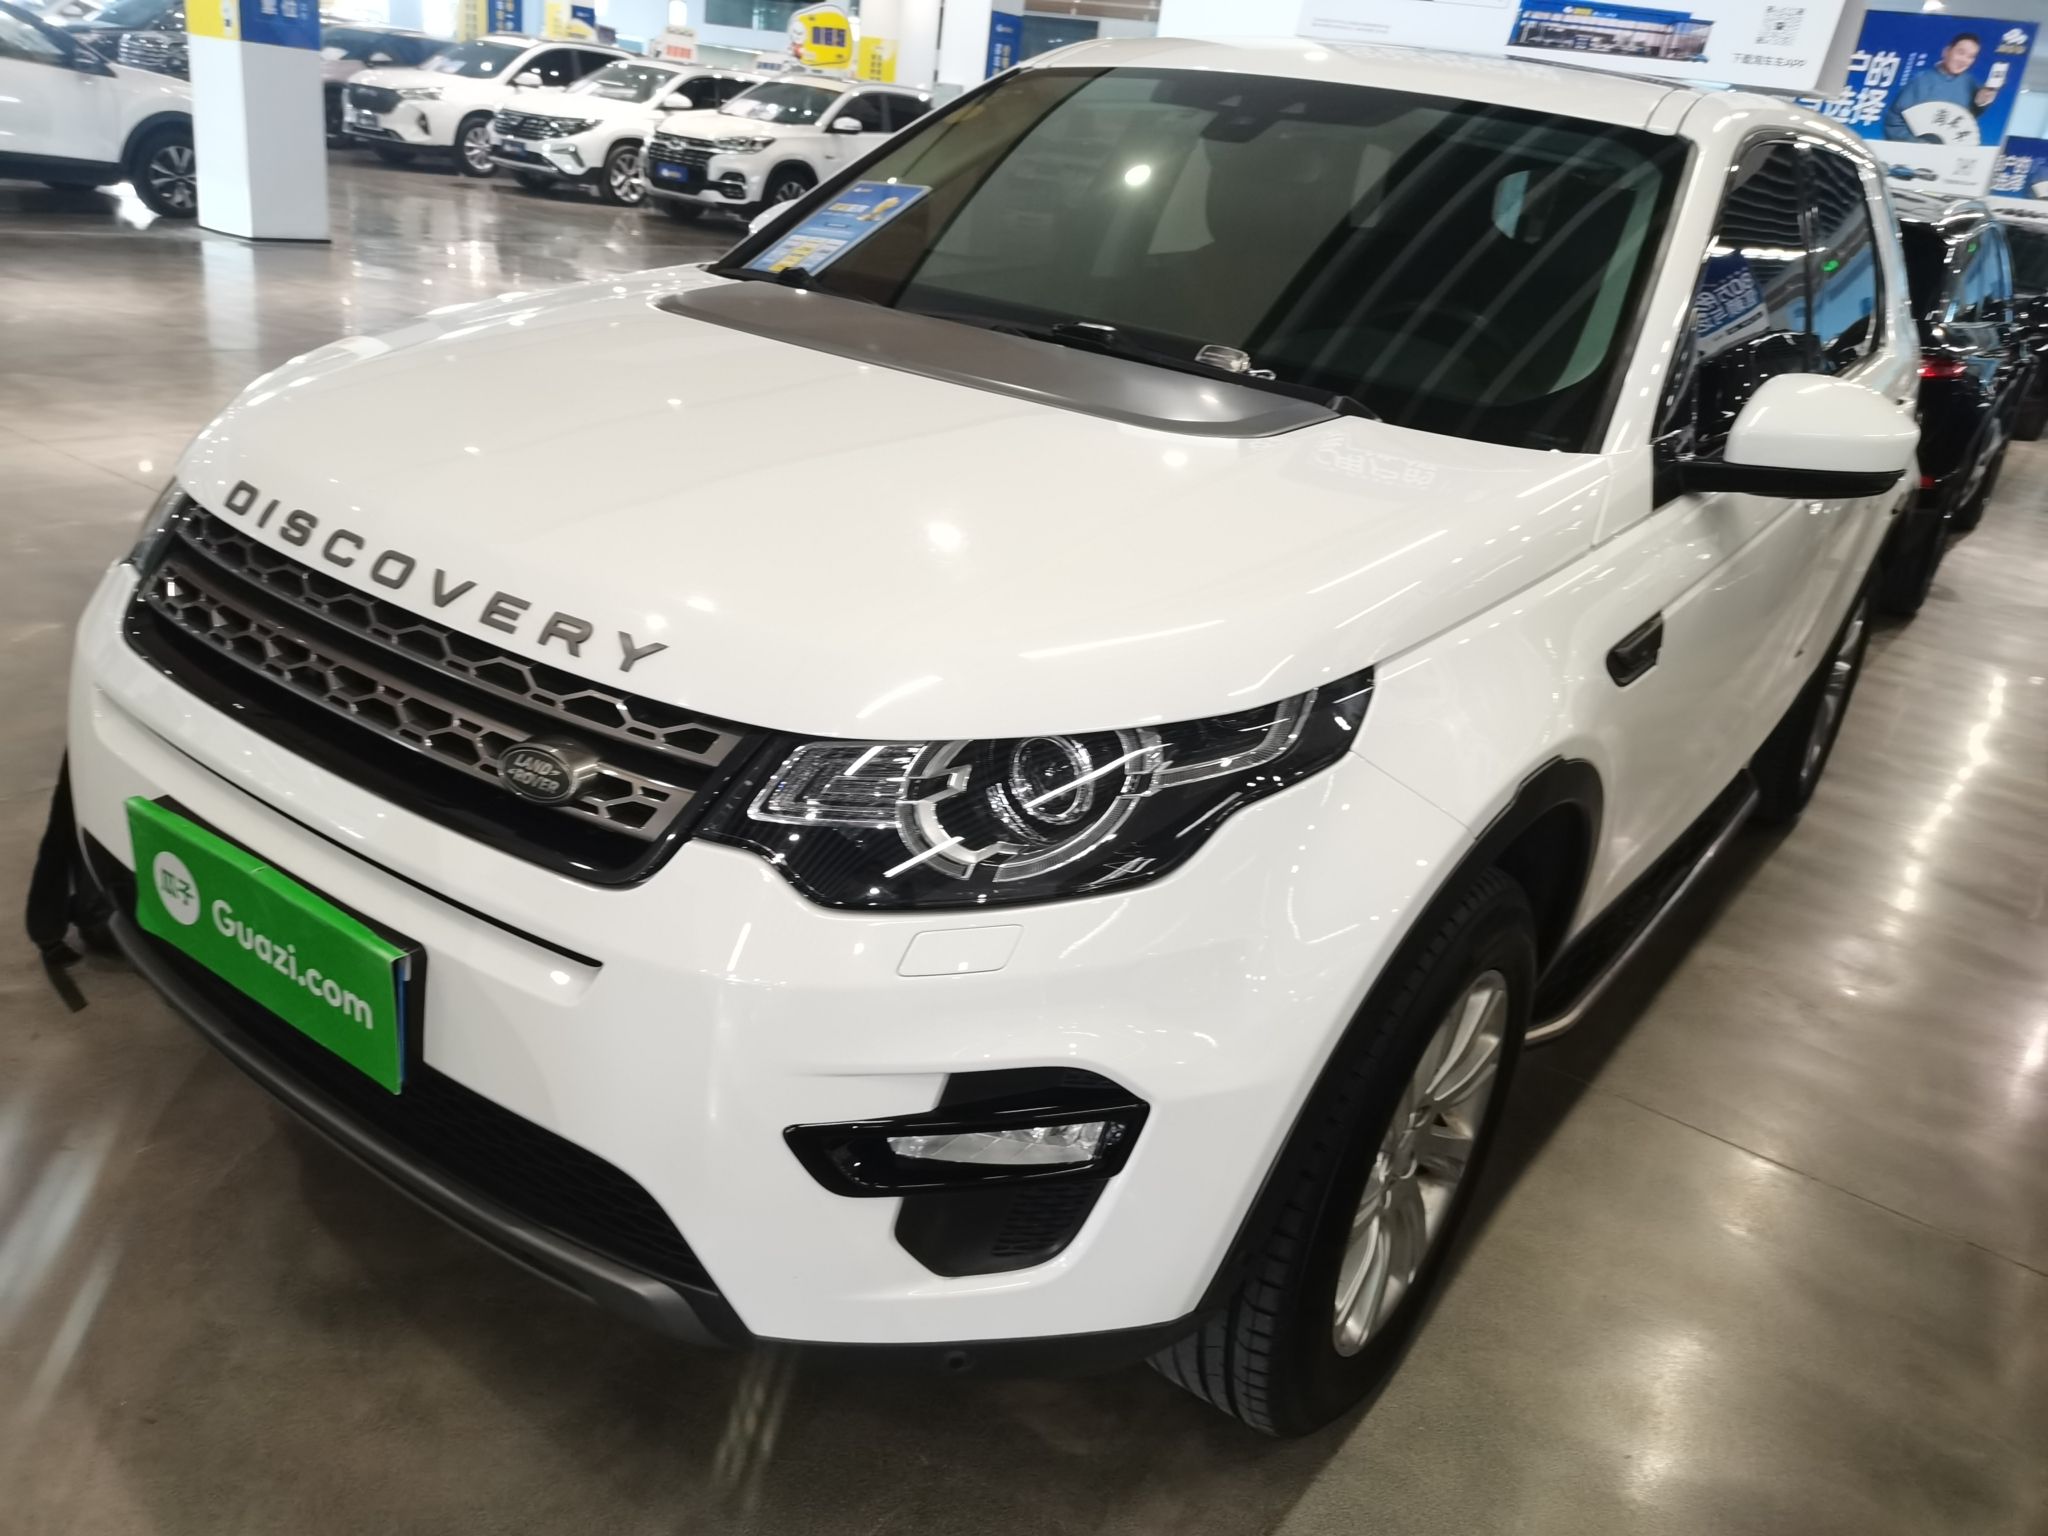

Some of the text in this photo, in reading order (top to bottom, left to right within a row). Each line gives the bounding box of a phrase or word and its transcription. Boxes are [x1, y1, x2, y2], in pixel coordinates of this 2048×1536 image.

[224, 480, 670, 673] DISCOVERY
[514, 753, 553, 776] LAND
[211, 899, 374, 1031] Guazi.com
